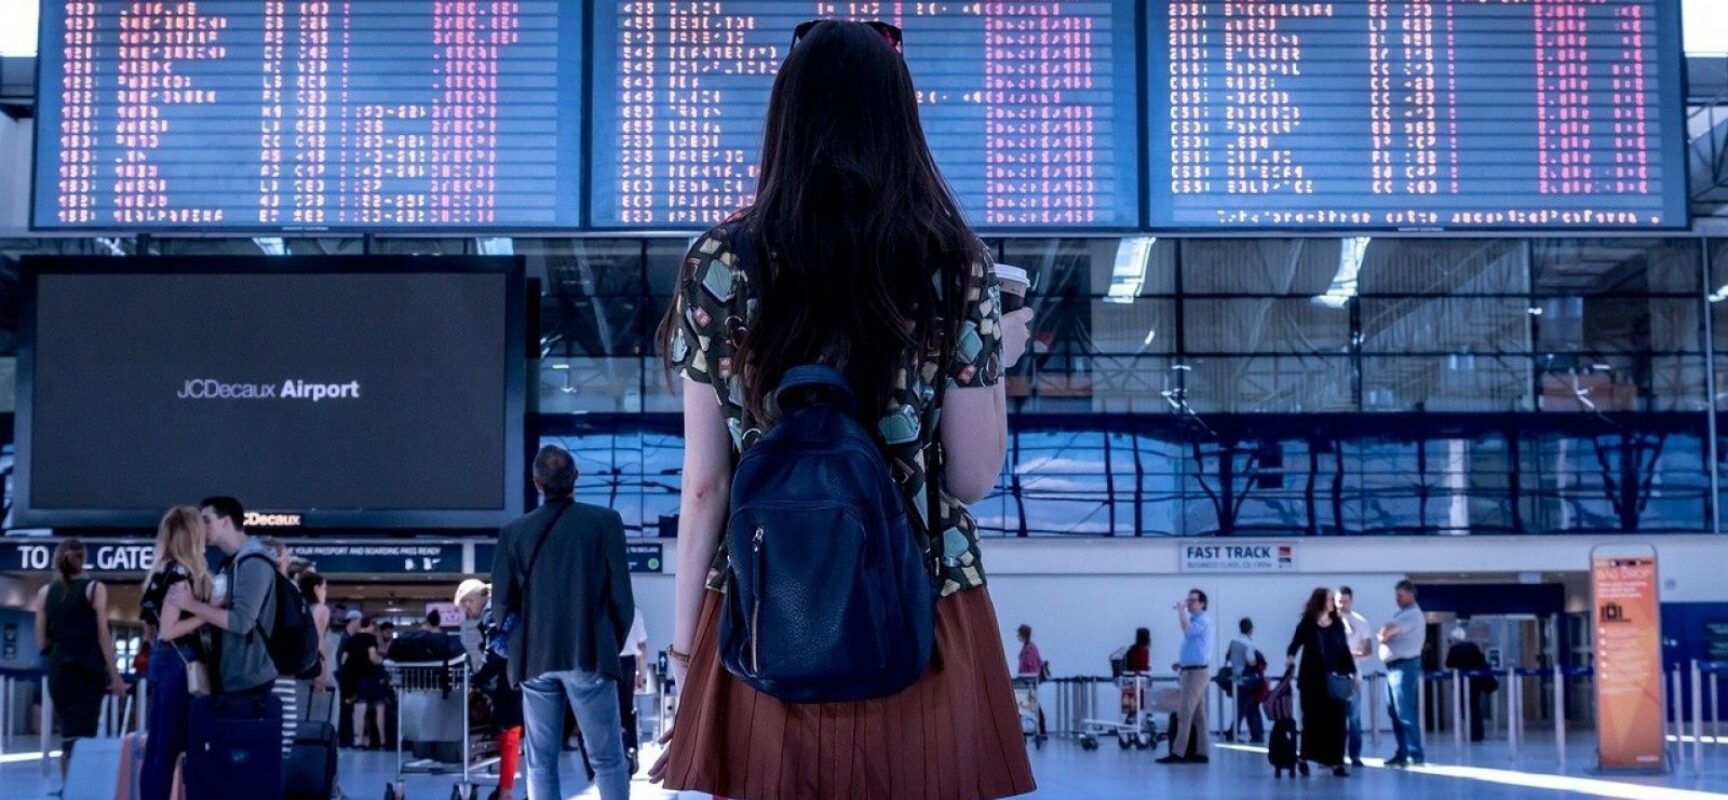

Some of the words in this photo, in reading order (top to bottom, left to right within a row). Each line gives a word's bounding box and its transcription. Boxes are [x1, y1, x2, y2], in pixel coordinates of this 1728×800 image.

[177, 379, 275, 398] JCDecaux
[280, 379, 360, 402] Airport
[17, 546, 49, 569] TO
[1187, 546, 1220, 558] FAST
[1225, 546, 1271, 558] TRACK
